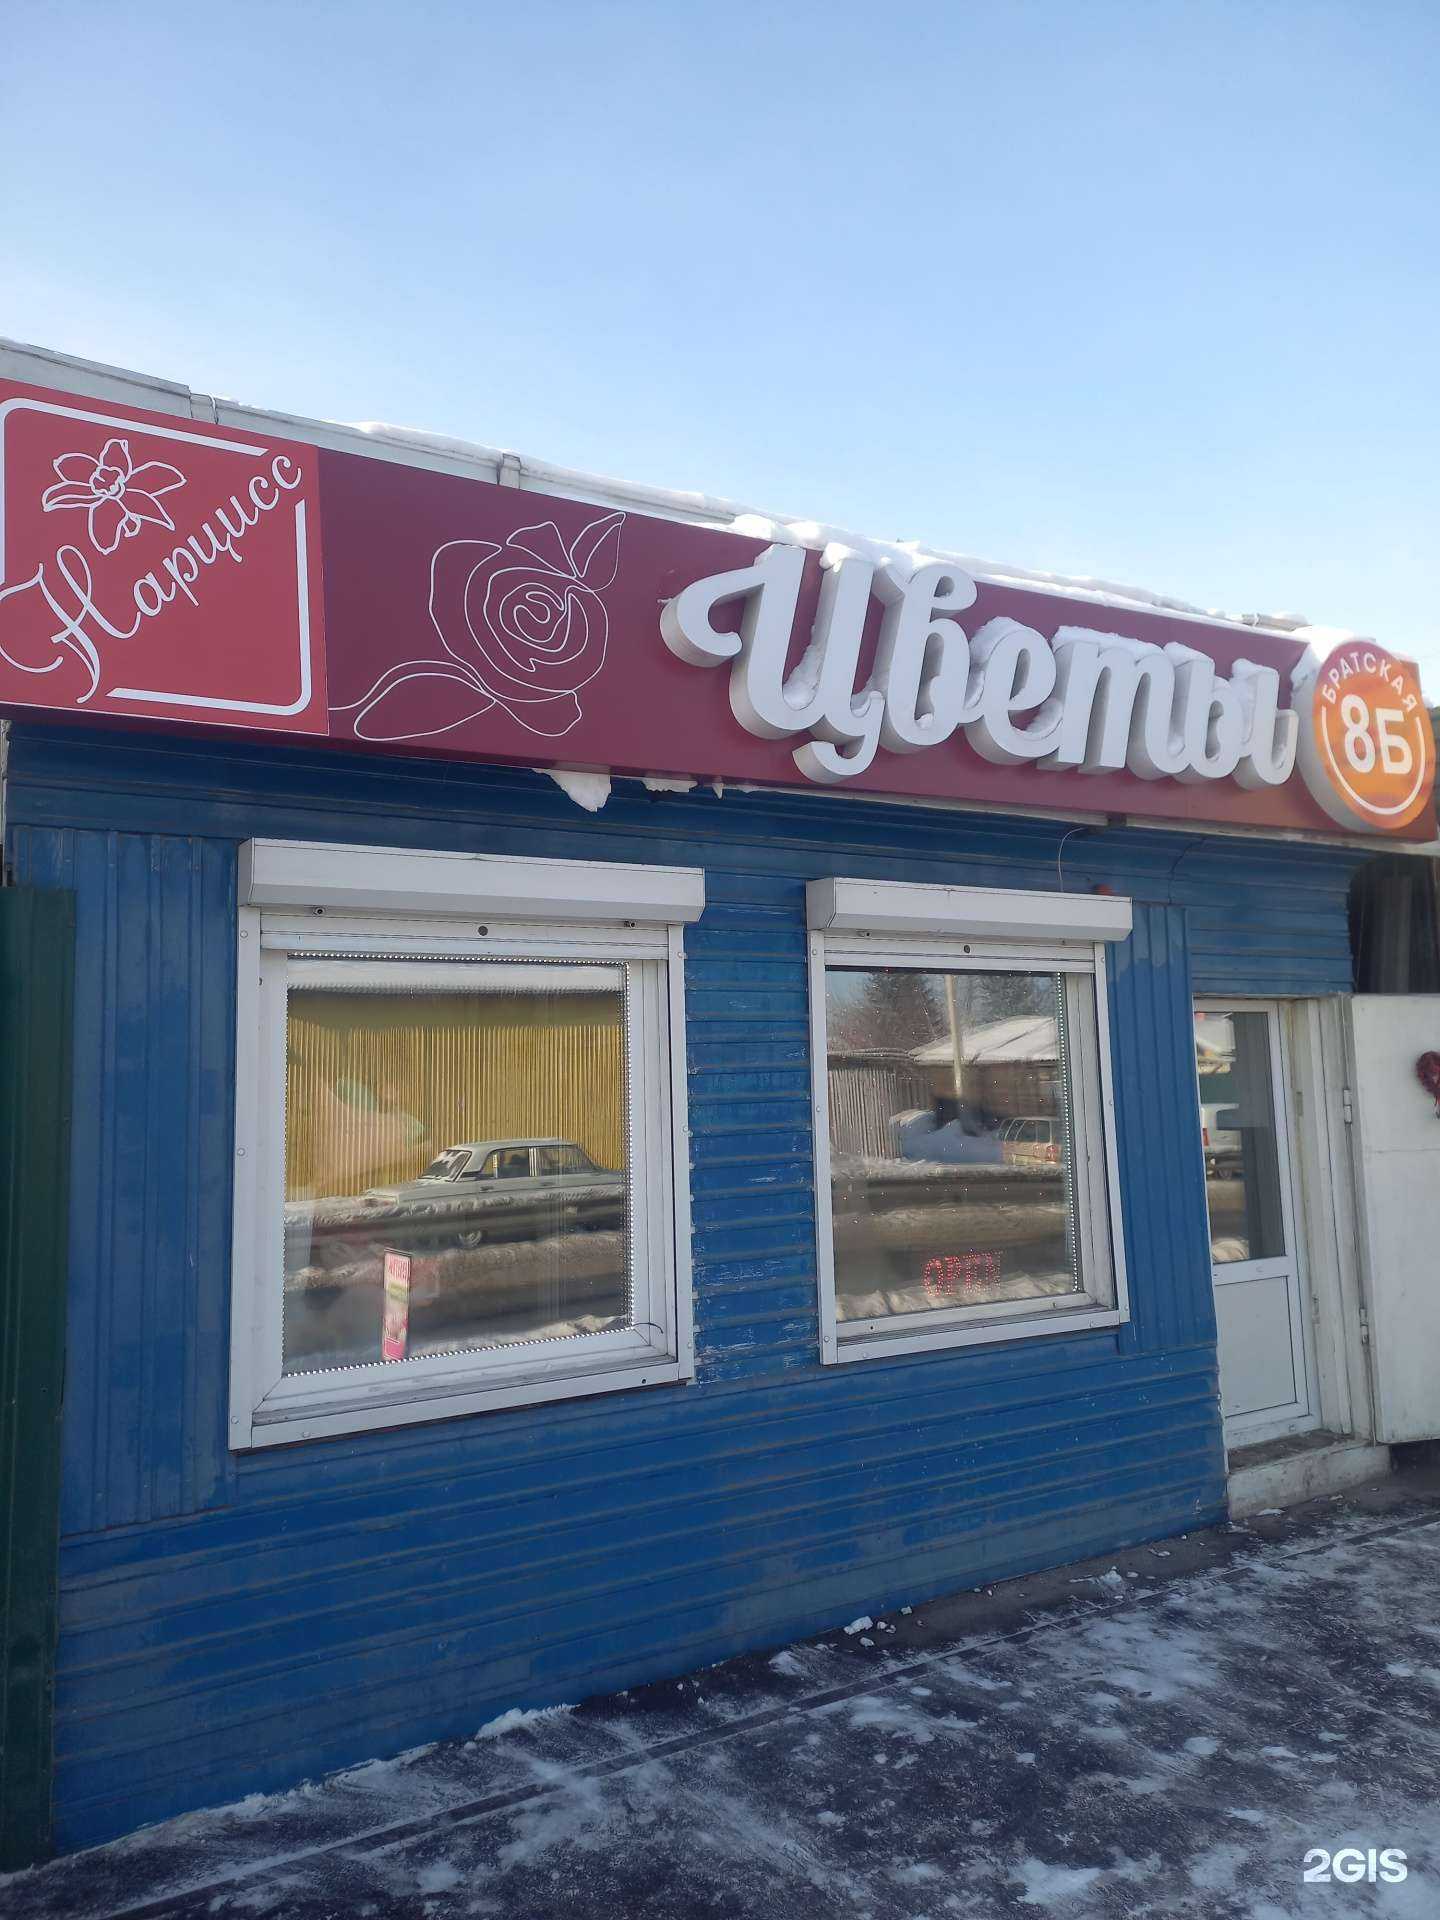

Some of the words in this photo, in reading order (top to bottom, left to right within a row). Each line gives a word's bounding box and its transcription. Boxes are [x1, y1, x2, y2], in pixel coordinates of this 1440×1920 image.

[0, 454, 302, 703] Нарцисс
[659, 543, 1298, 784] Цветы
[1321, 652, 1418, 711] БРАТСКАЯ
[1340, 693, 1413, 775] 8Б
